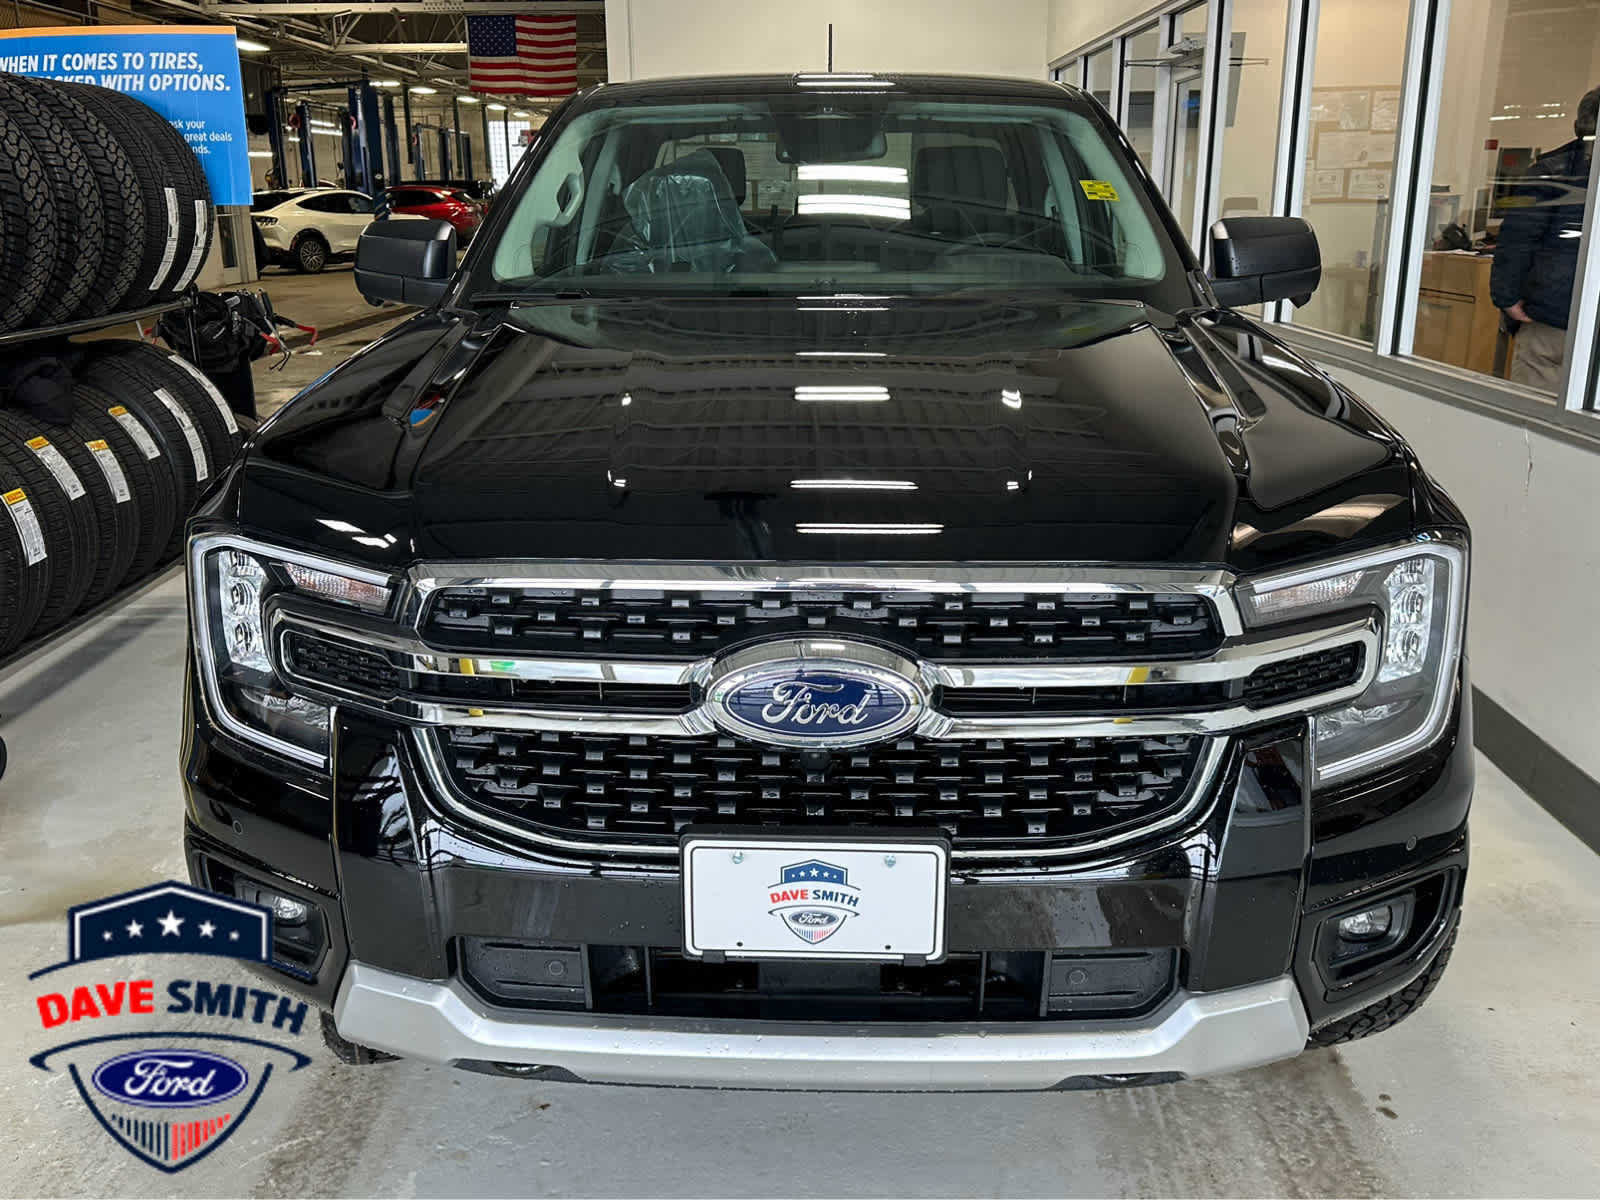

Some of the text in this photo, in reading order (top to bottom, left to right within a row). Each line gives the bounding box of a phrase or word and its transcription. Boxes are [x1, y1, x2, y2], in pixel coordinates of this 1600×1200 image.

[0, 52, 204, 73] WHEN IT COMES TO TIRES,
[101, 74, 145, 92] WITH
[149, 74, 231, 92] OPTIONS.
[185, 120, 206, 130] your
[183, 131, 233, 143] great deals
[762, 681, 871, 725] Ford
[770, 888, 860, 907] DAVE SMITH
